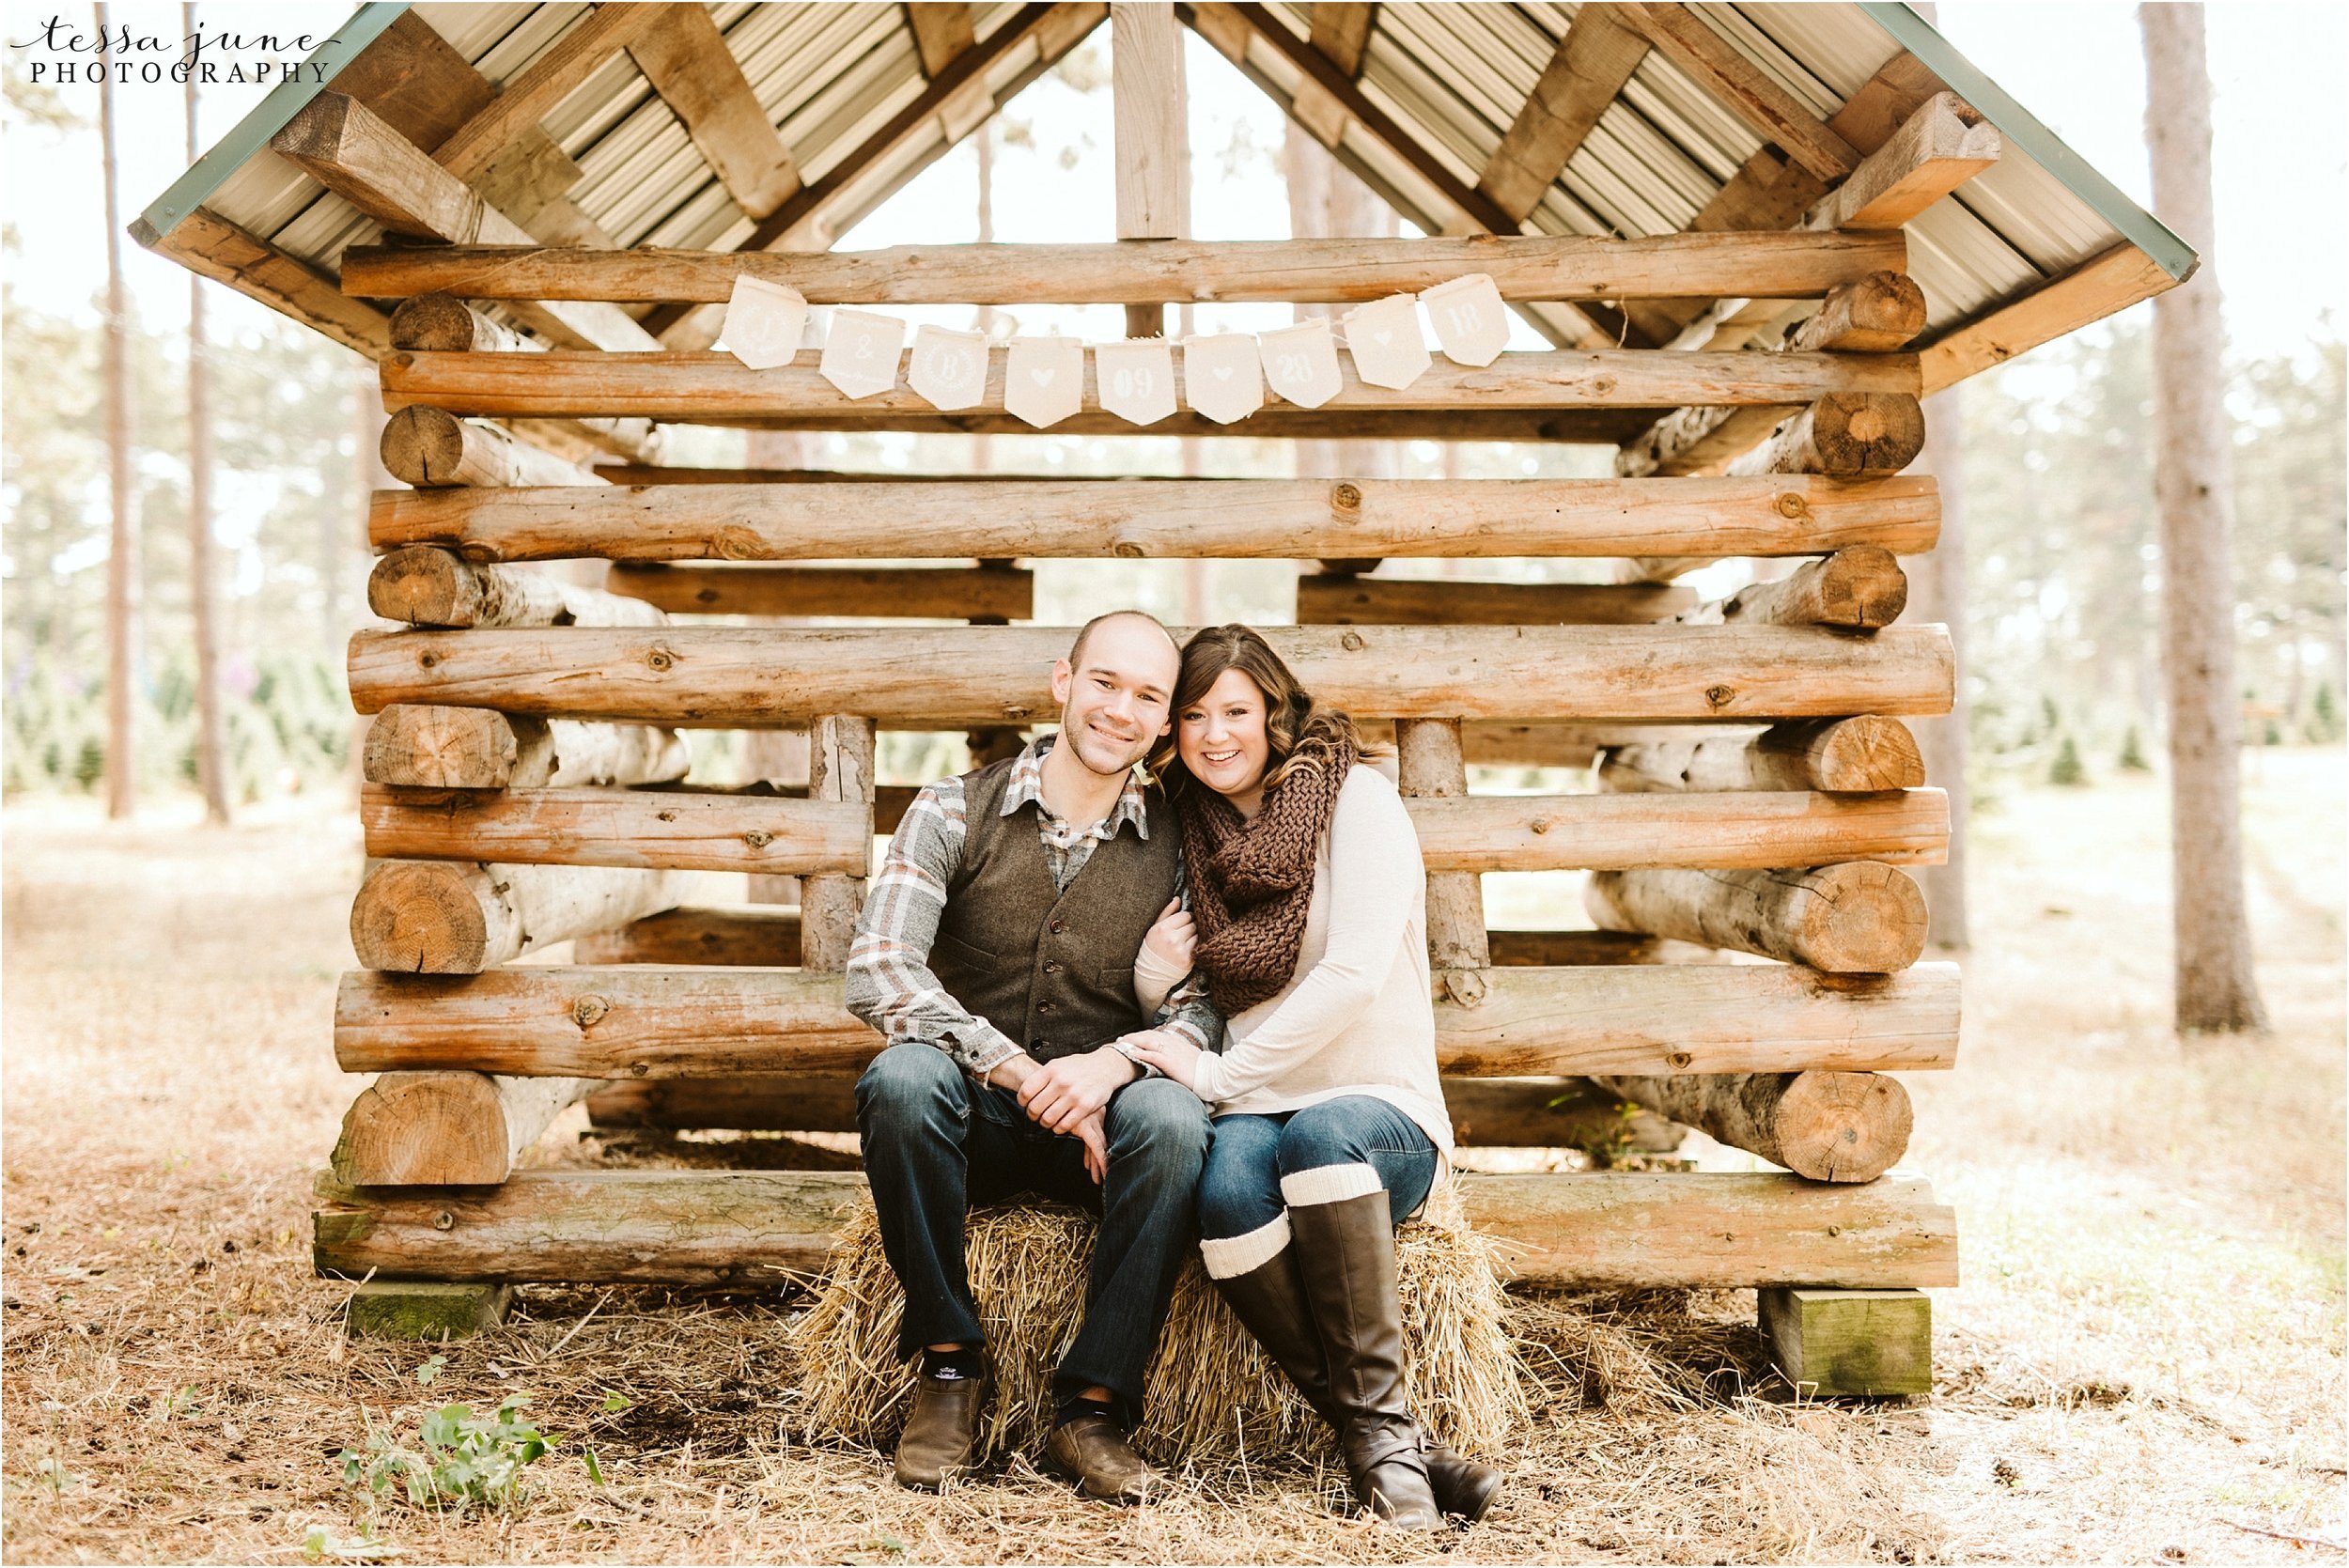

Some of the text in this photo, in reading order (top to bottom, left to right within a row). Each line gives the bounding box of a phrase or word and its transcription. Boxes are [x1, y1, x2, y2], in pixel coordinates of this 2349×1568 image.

[856, 334, 874, 360] &
[941, 352, 958, 380] B
[1113, 367, 1153, 398] 09
[1446, 302, 1484, 338] 18
